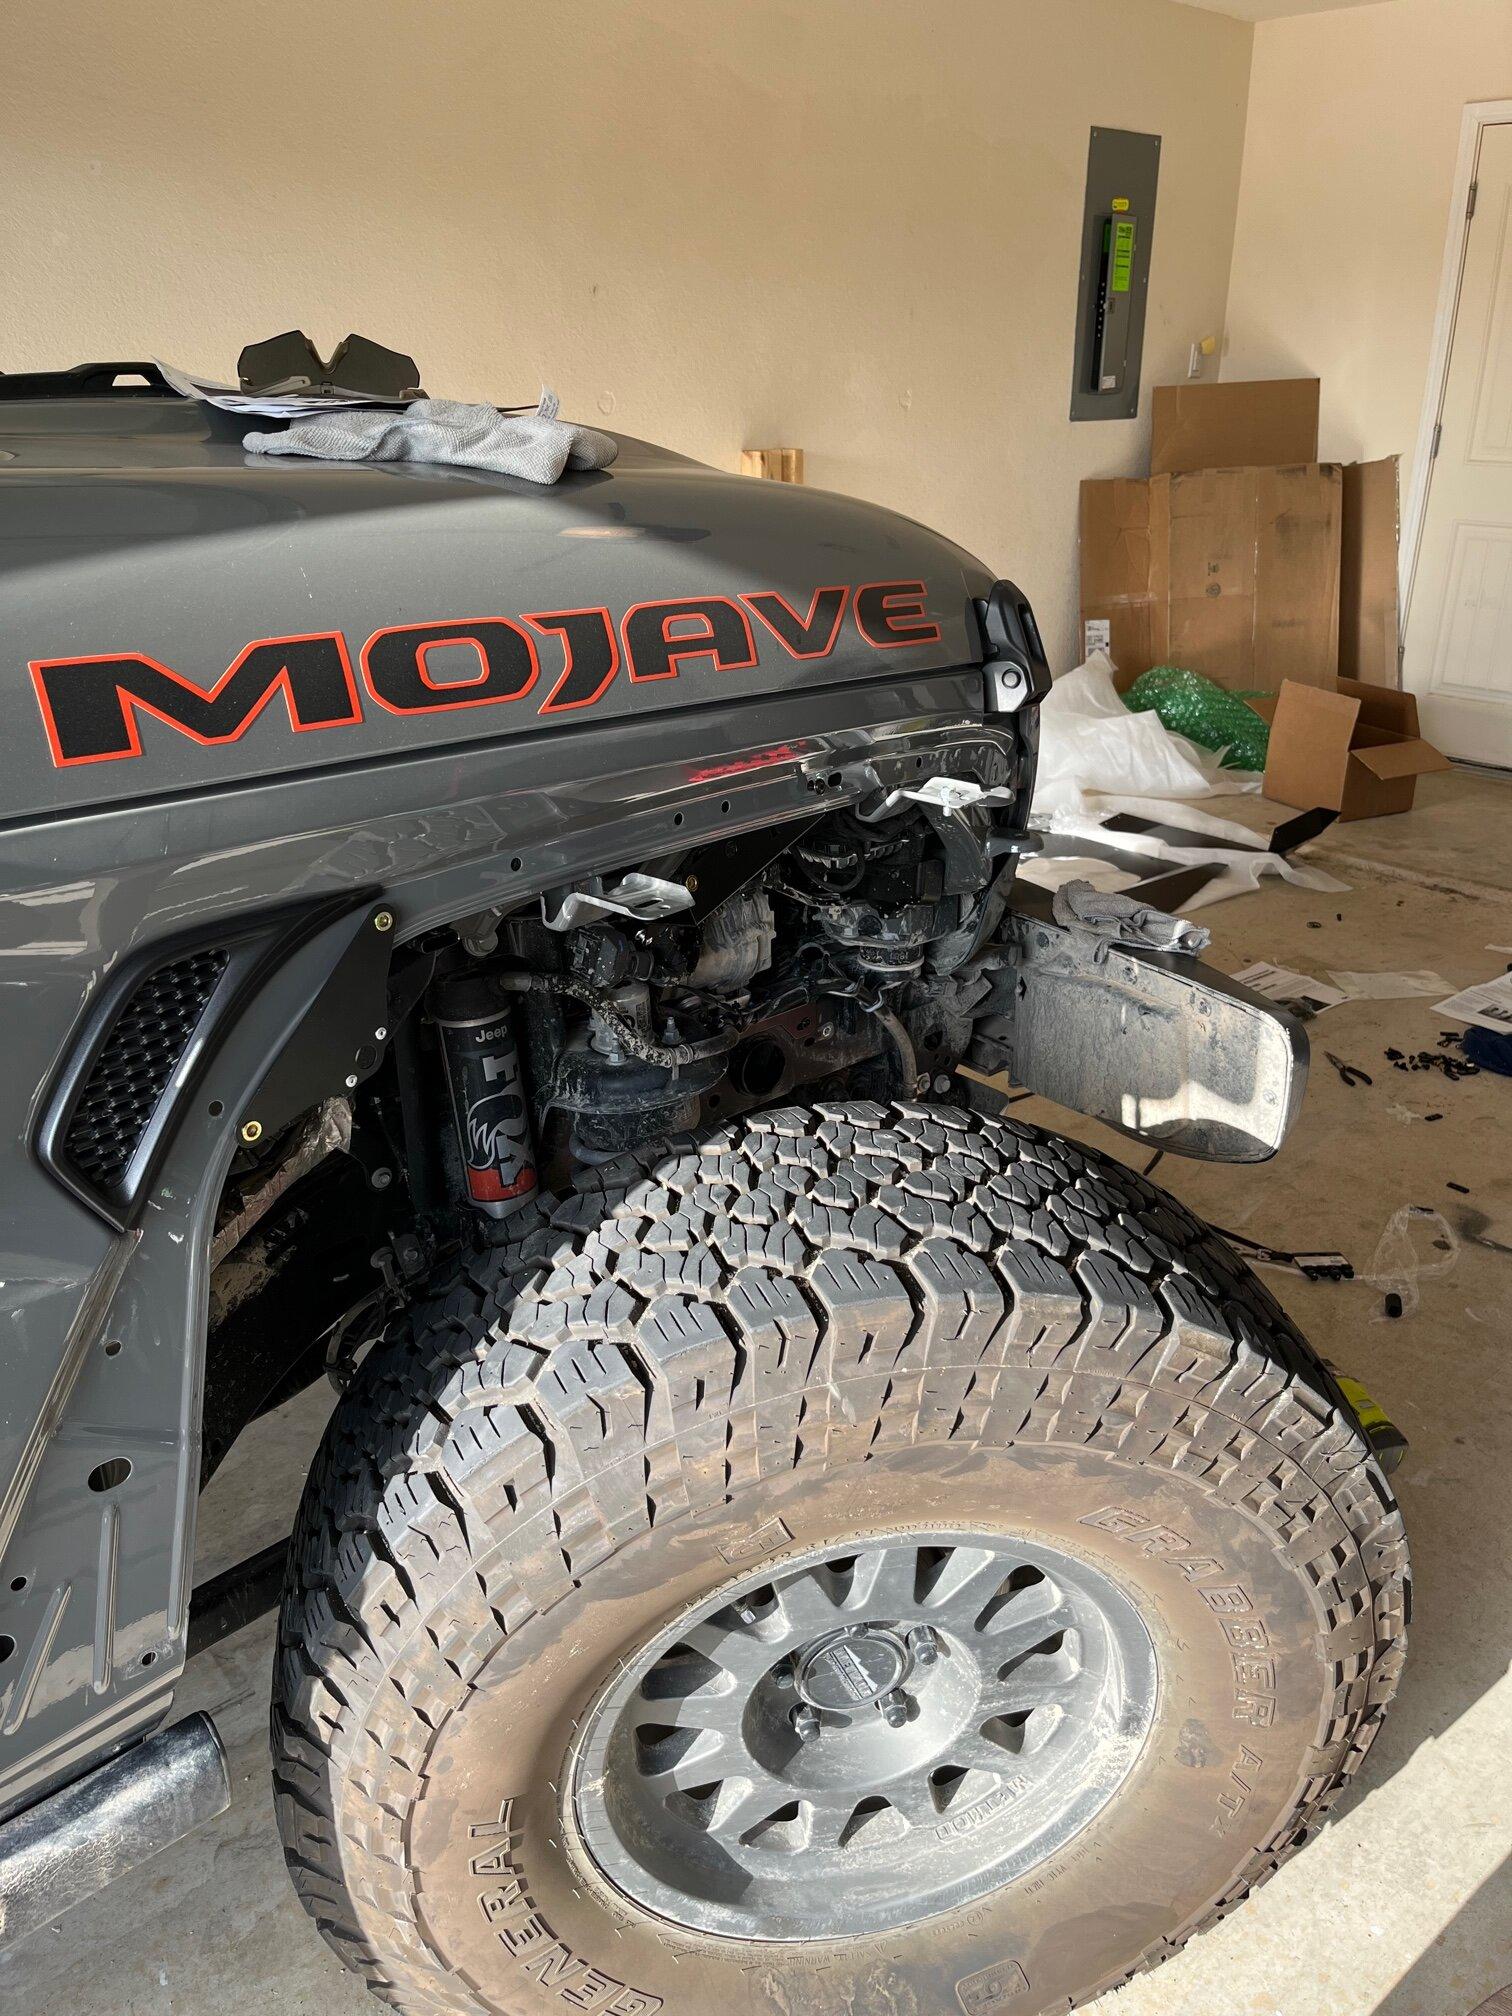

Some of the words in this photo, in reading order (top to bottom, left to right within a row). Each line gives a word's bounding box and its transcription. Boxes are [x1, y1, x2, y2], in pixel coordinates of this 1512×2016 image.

[27, 580, 942, 768] MOJAVE
[475, 1023, 508, 1043] Jeep
[1075, 1505, 1277, 1727] GRABBER
